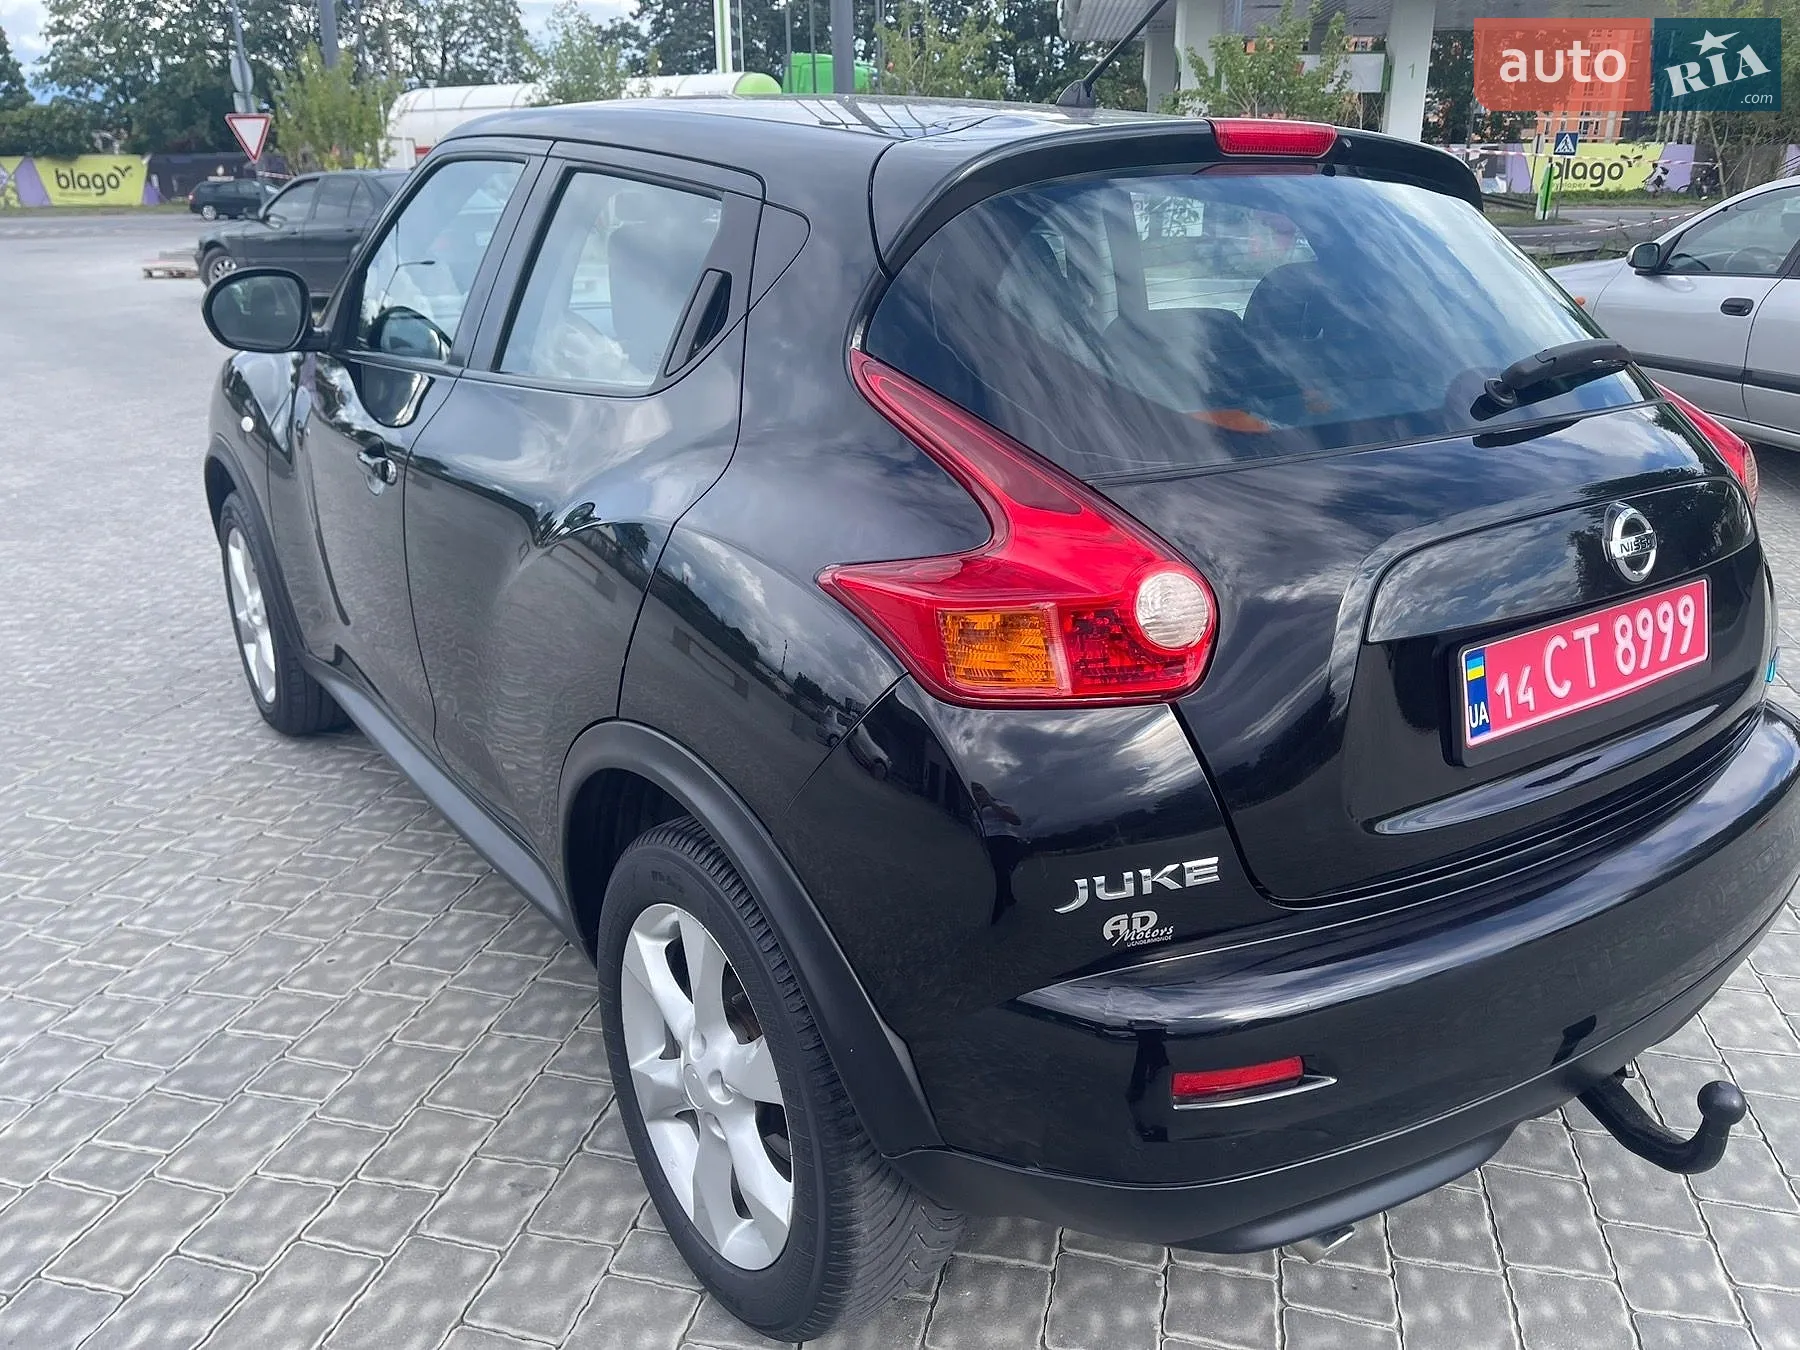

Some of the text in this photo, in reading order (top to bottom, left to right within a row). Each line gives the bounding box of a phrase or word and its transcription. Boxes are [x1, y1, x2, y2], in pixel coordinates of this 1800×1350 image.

[55, 168, 120, 195] blago
[1495, 594, 1695, 719] 14 CT 8999
[1469, 701, 1490, 729] UA
[1054, 856, 1221, 914] JUKE
[1103, 910, 1158, 940] AD
[1112, 925, 1174, 946] Motors
